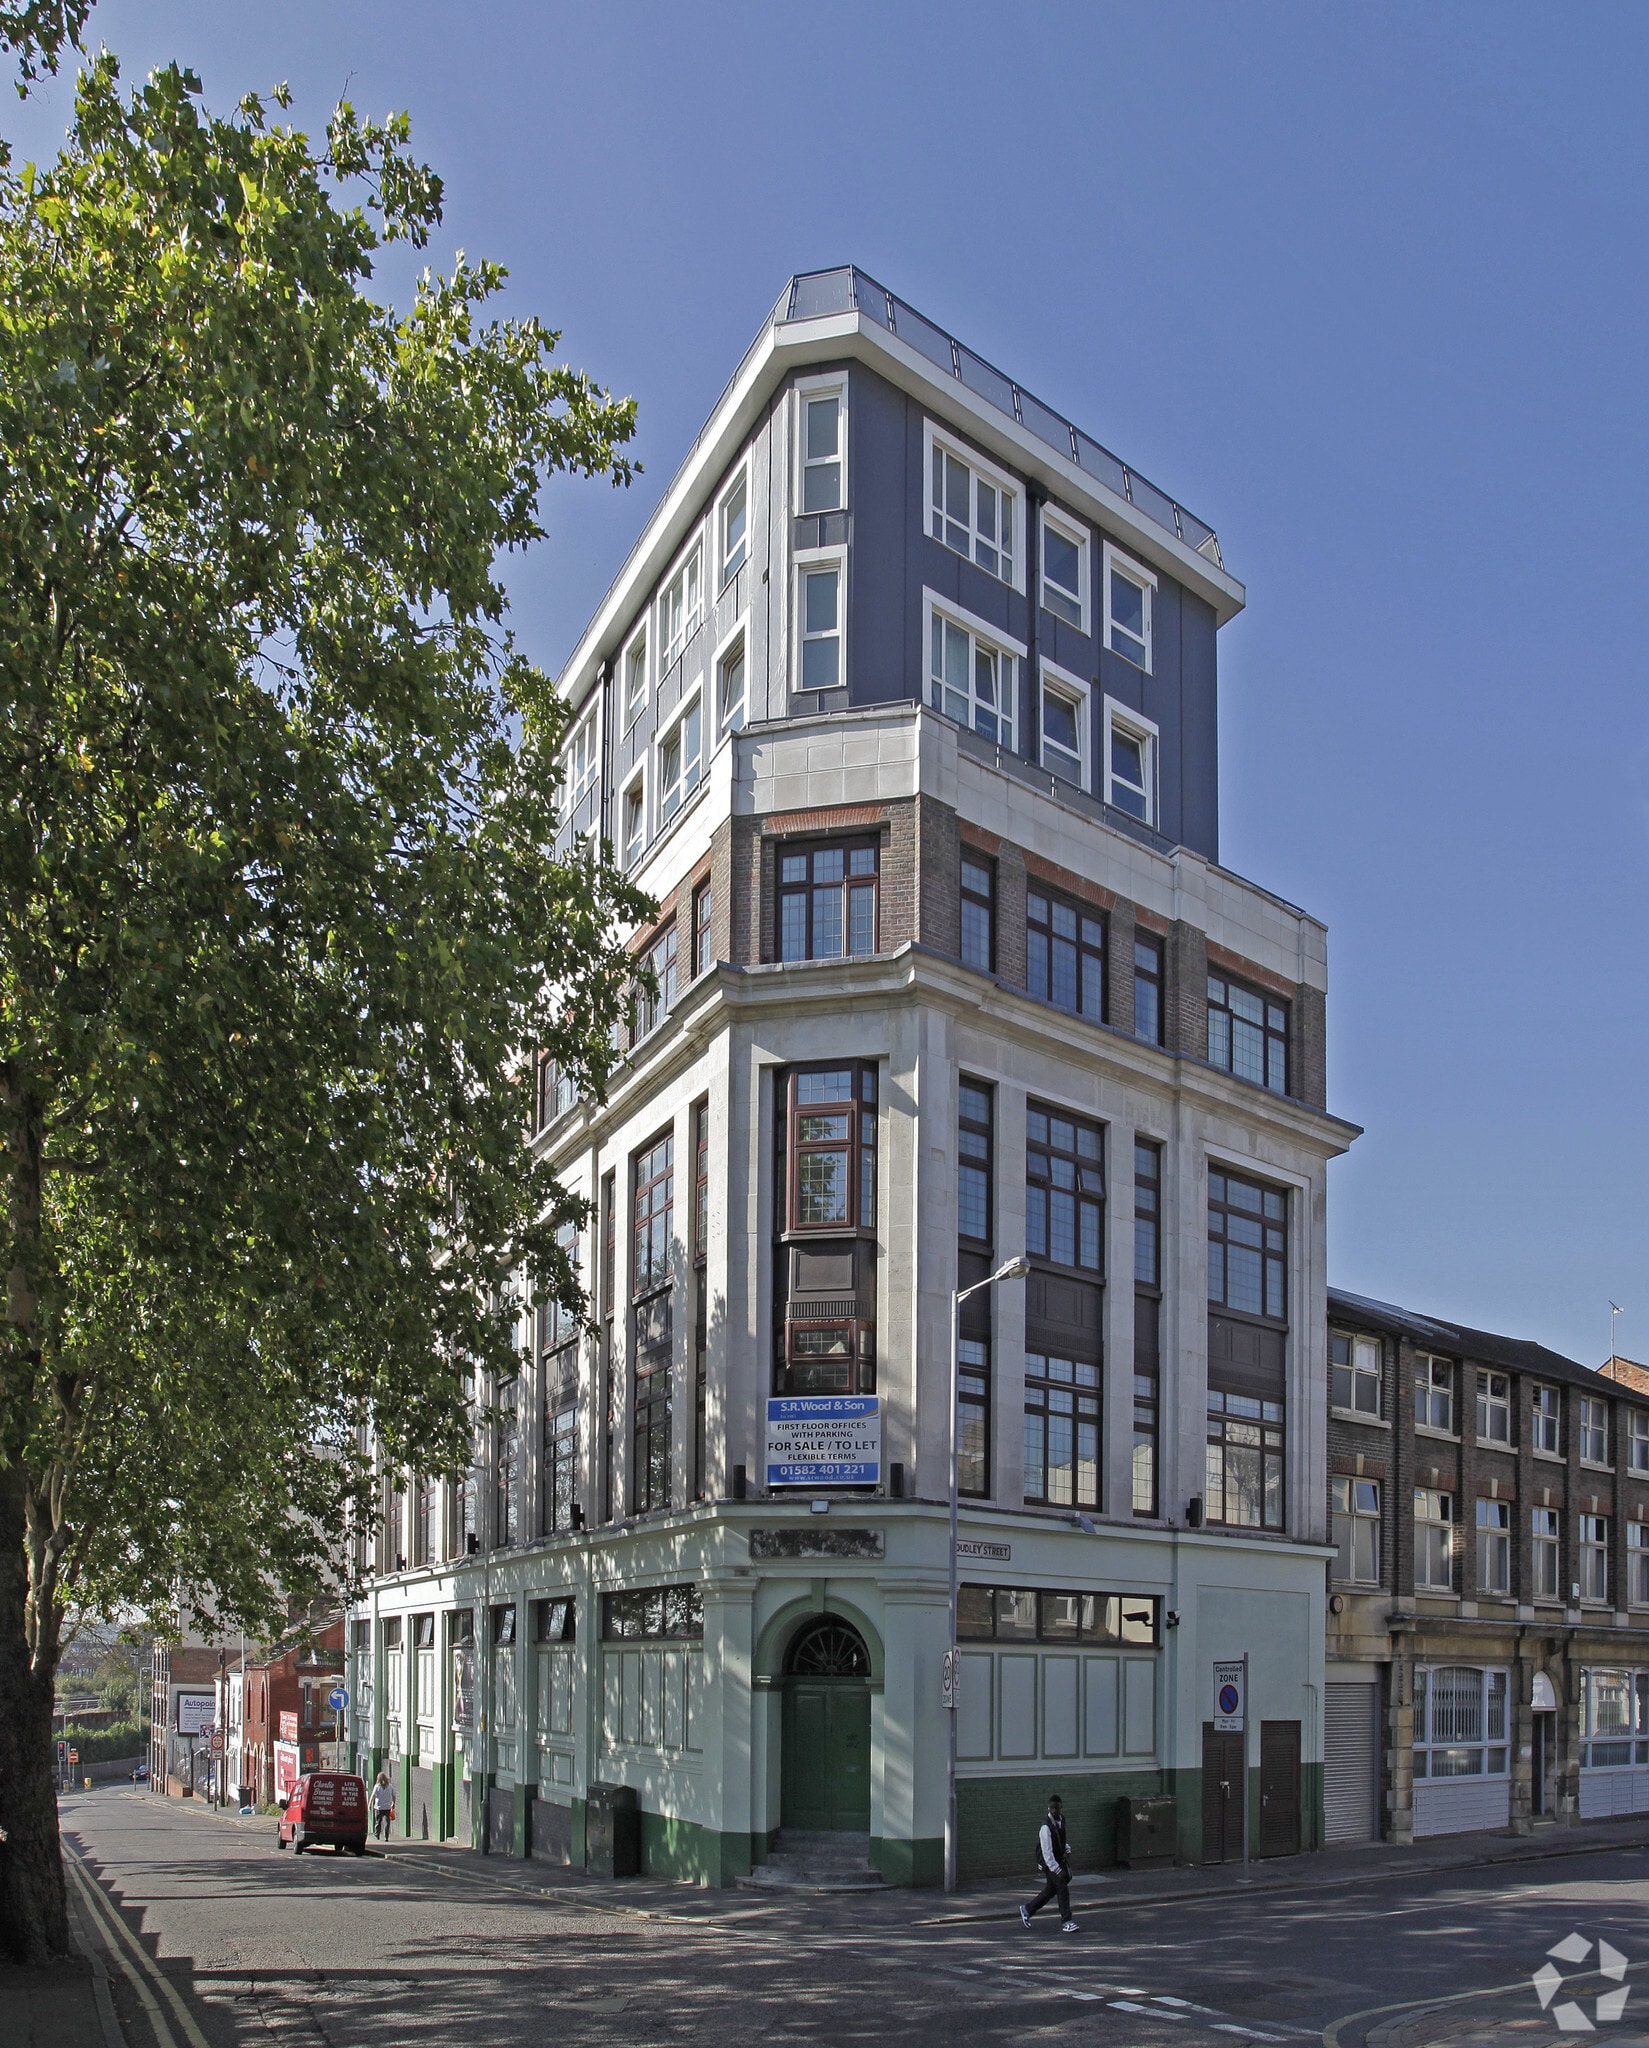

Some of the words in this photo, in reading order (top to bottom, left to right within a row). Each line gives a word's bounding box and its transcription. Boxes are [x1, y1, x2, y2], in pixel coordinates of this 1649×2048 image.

[801, 1401, 831, 1410] Wood
[834, 1401, 842, 1410] &
[844, 1401, 864, 1410] Son
[768, 1442, 791, 1451] FOR
[795, 1441, 824, 1450] SALE
[828, 1441, 832, 1450] /
[835, 1441, 851, 1450] TO
[855, 1441, 877, 1450] LET
[780, 1465, 816, 1475] 01582
[819, 1465, 840, 1474] 401
[844, 1465, 865, 1474] 221
[983, 1546, 1008, 1556] STREET
